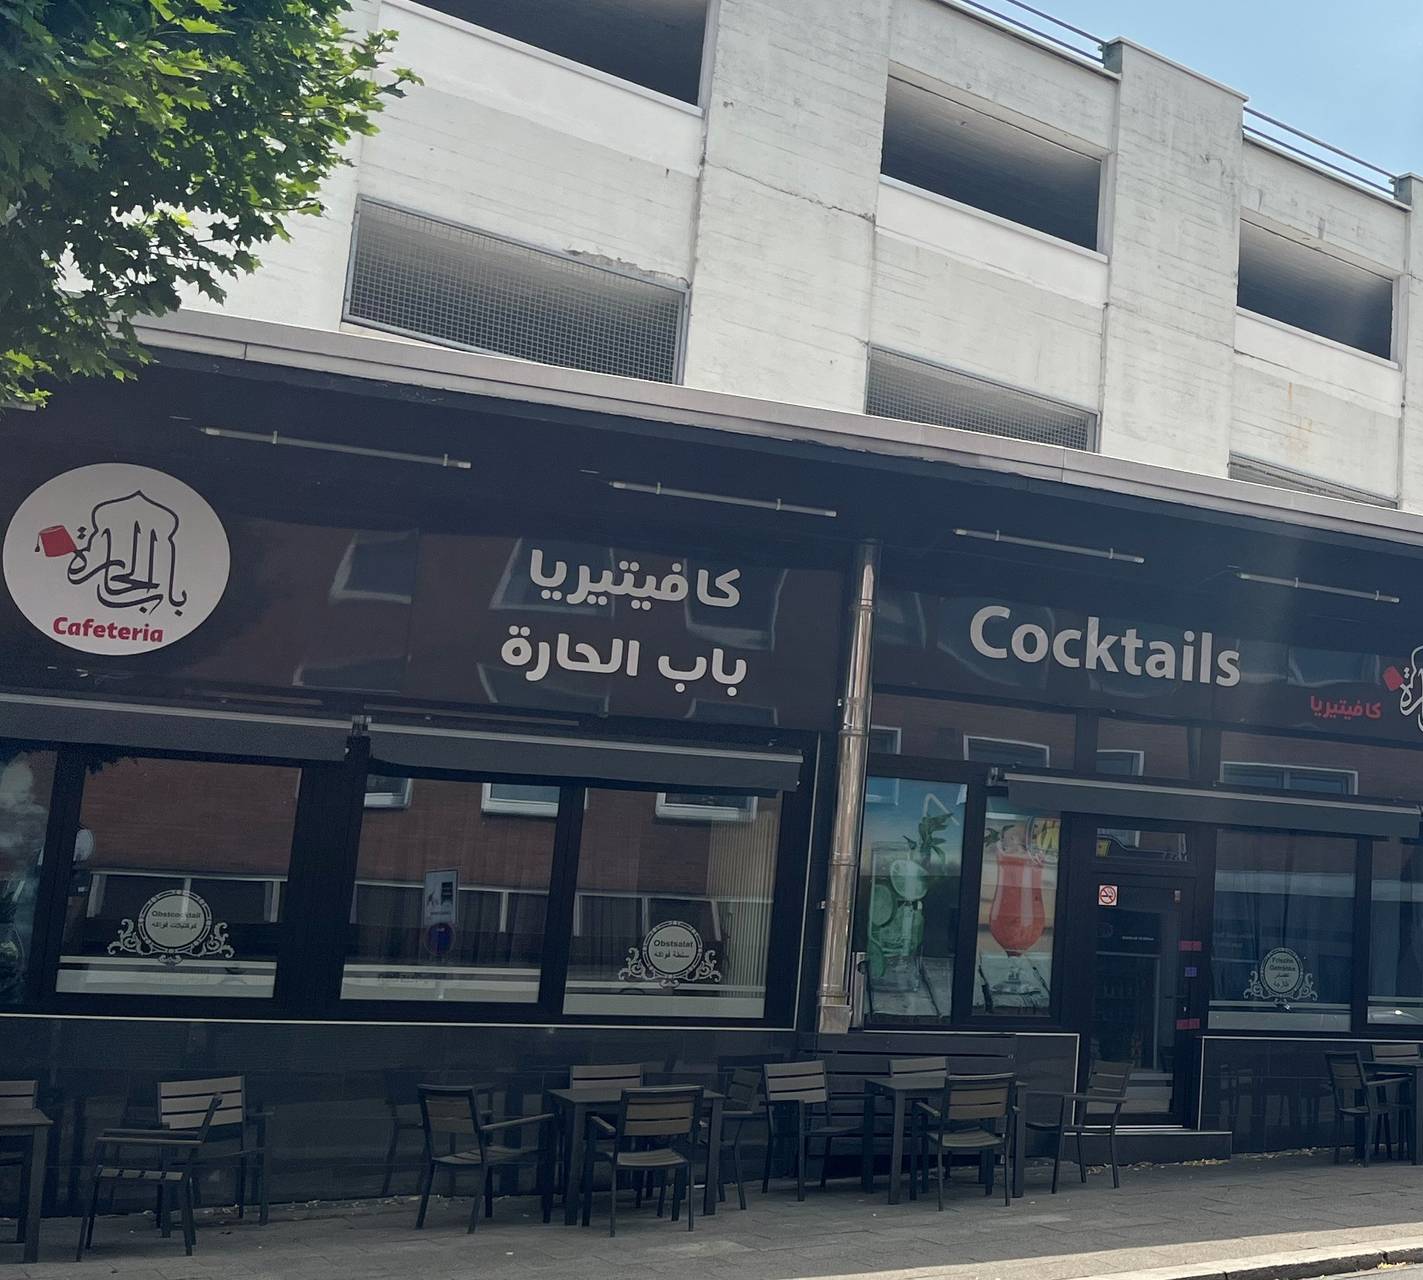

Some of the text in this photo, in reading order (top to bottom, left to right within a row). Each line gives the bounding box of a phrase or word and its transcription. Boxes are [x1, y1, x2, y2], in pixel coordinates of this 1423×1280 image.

[529, 549, 742, 611] كافيتيريا
[53, 616, 164, 643] Cafeteria
[969, 605, 1242, 688] Cocktails
[500, 624, 748, 697] باب الحارة
[1310, 695, 1383, 720] كافيتيريا
[653, 939, 694, 948] Obstsalat
